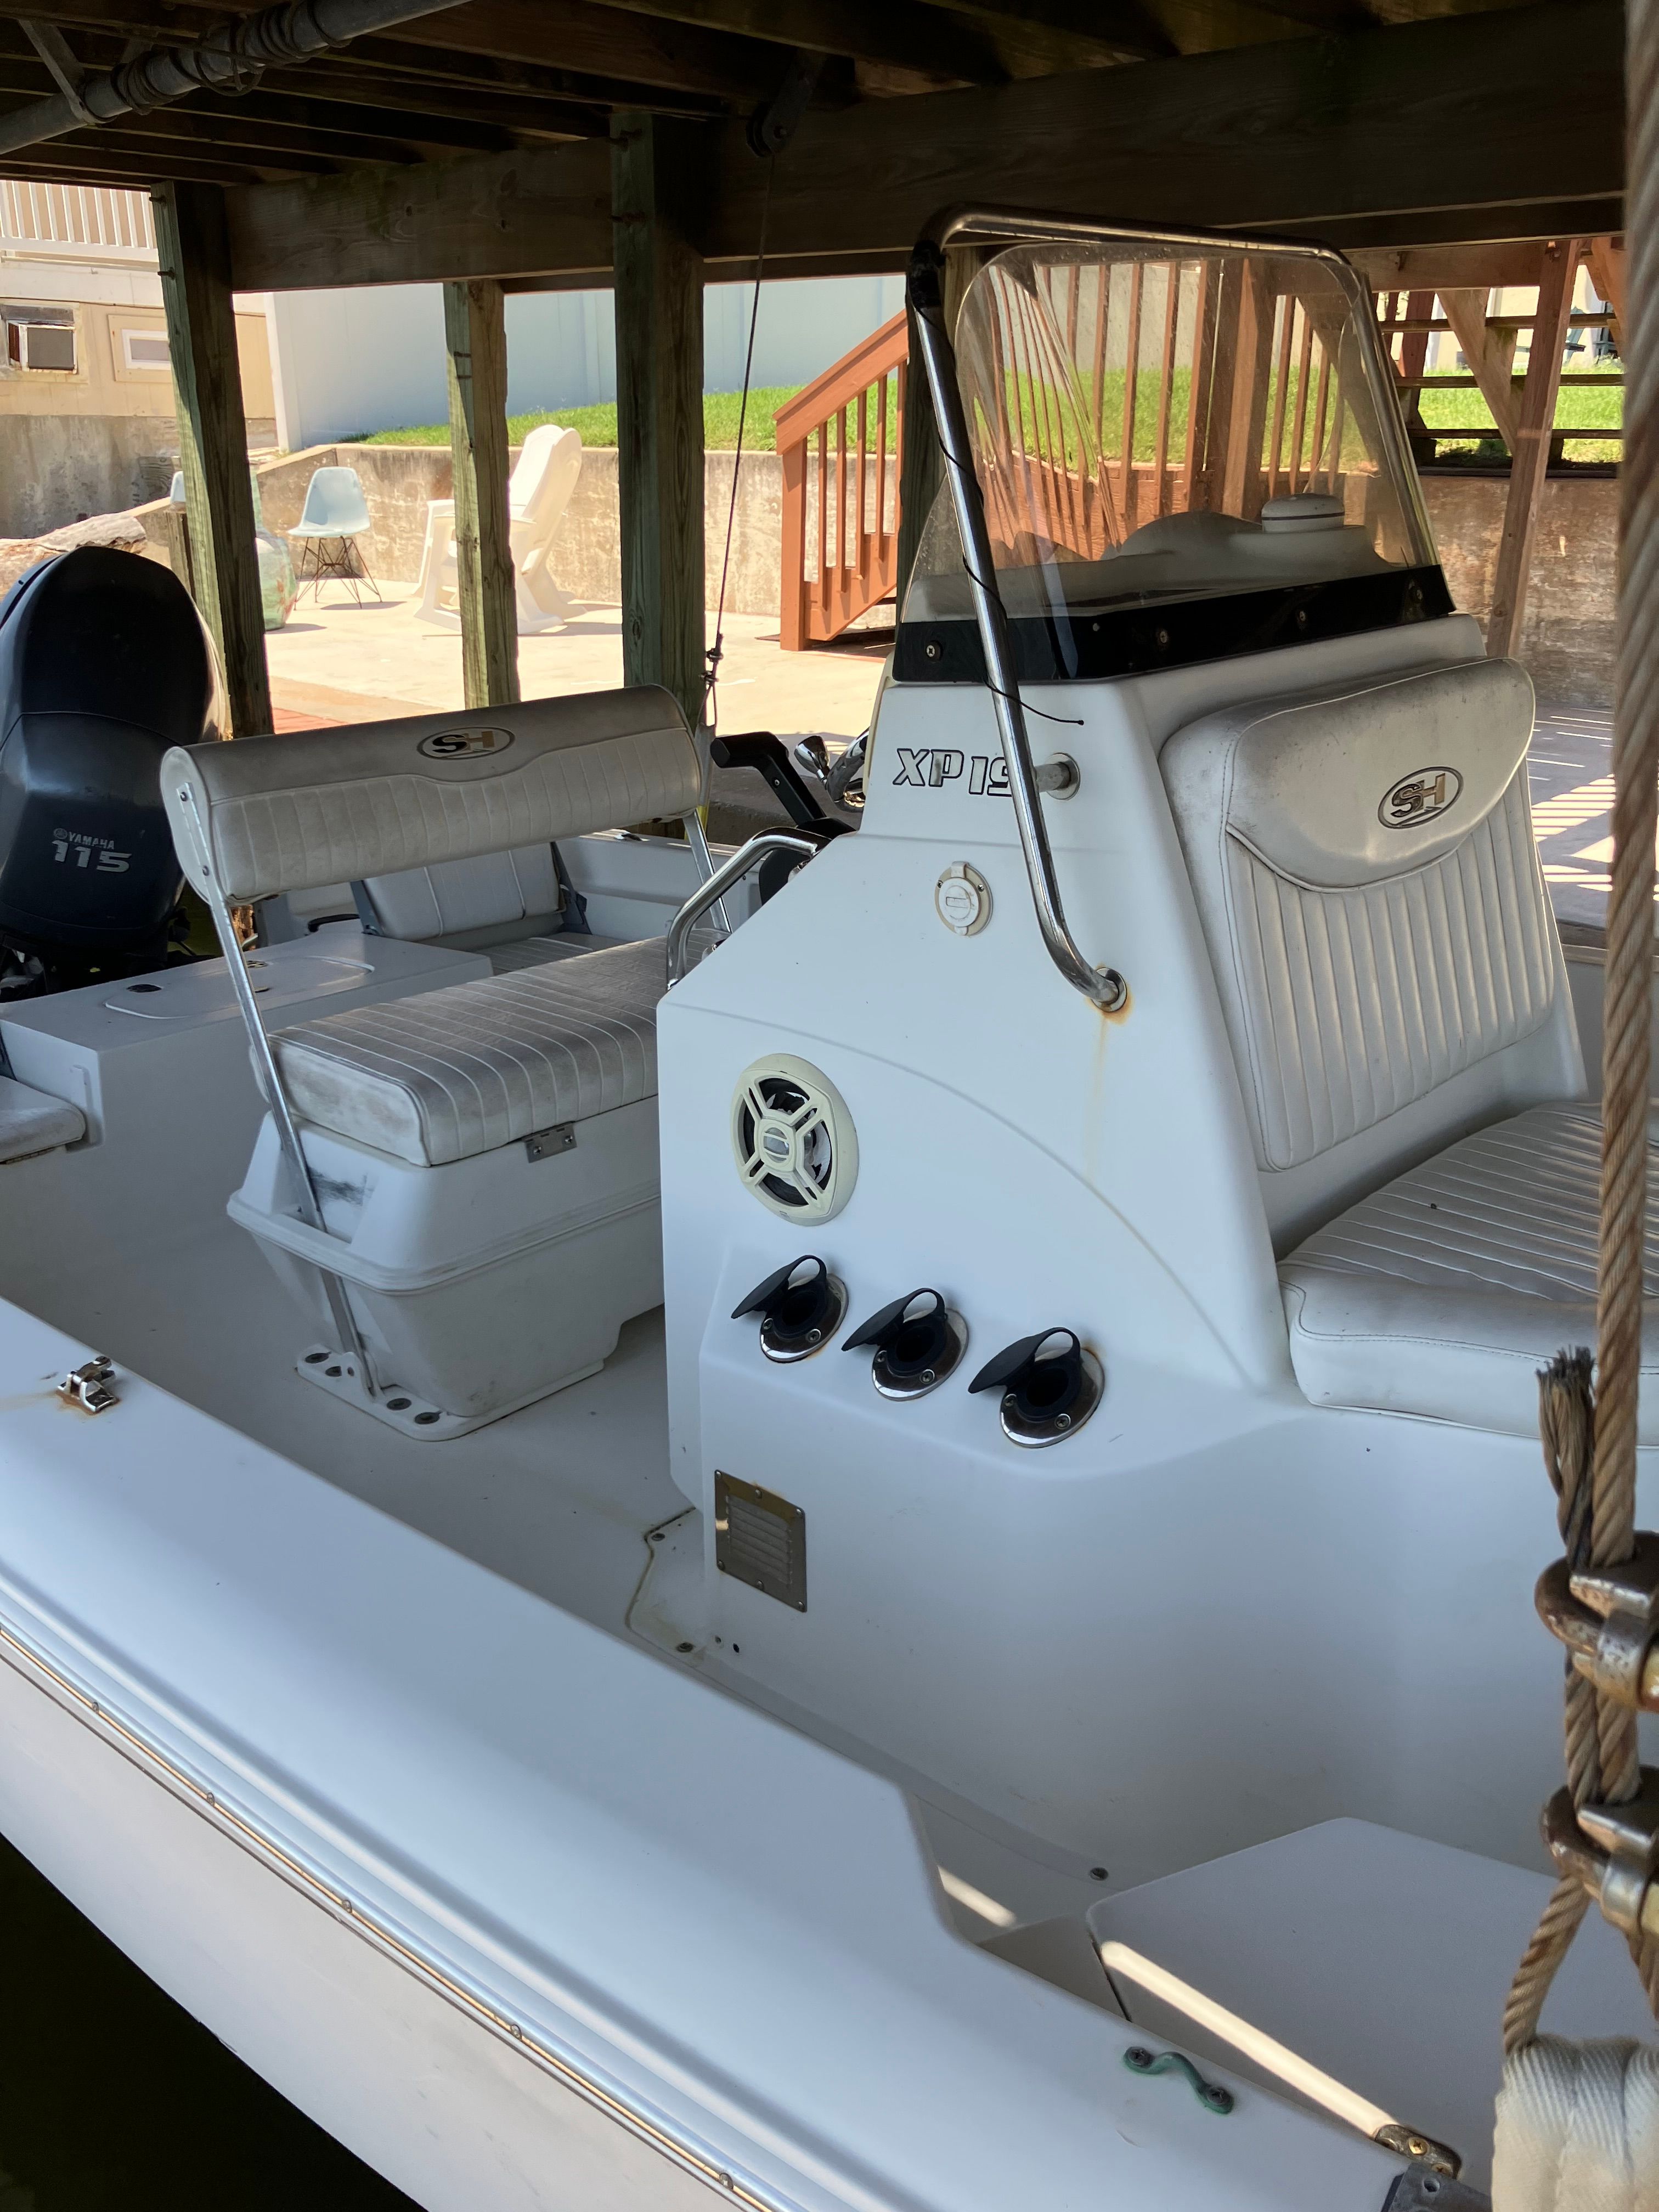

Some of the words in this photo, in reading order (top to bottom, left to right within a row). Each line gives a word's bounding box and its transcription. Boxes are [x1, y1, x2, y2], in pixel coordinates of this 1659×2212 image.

[1391, 773, 1446, 817] SH
[52, 840, 132, 872] 115
[69, 832, 115, 850] YAMAHA
